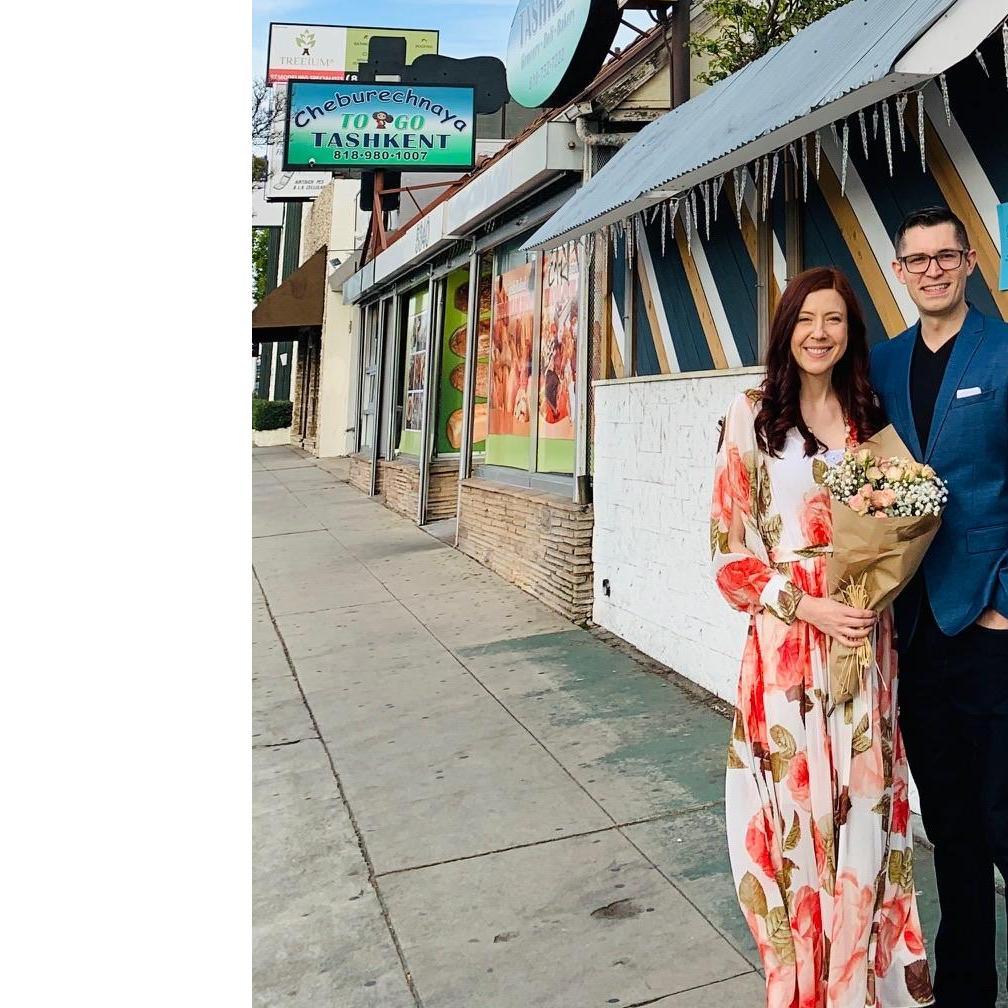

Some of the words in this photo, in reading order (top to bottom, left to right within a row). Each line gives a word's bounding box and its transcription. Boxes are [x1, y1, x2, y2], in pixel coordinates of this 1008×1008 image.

[294, 89, 467, 132] Cheburechnaya
[340, 113, 369, 130] TO
[394, 113, 425, 130] GO
[311, 132, 451, 149] TASHKENT
